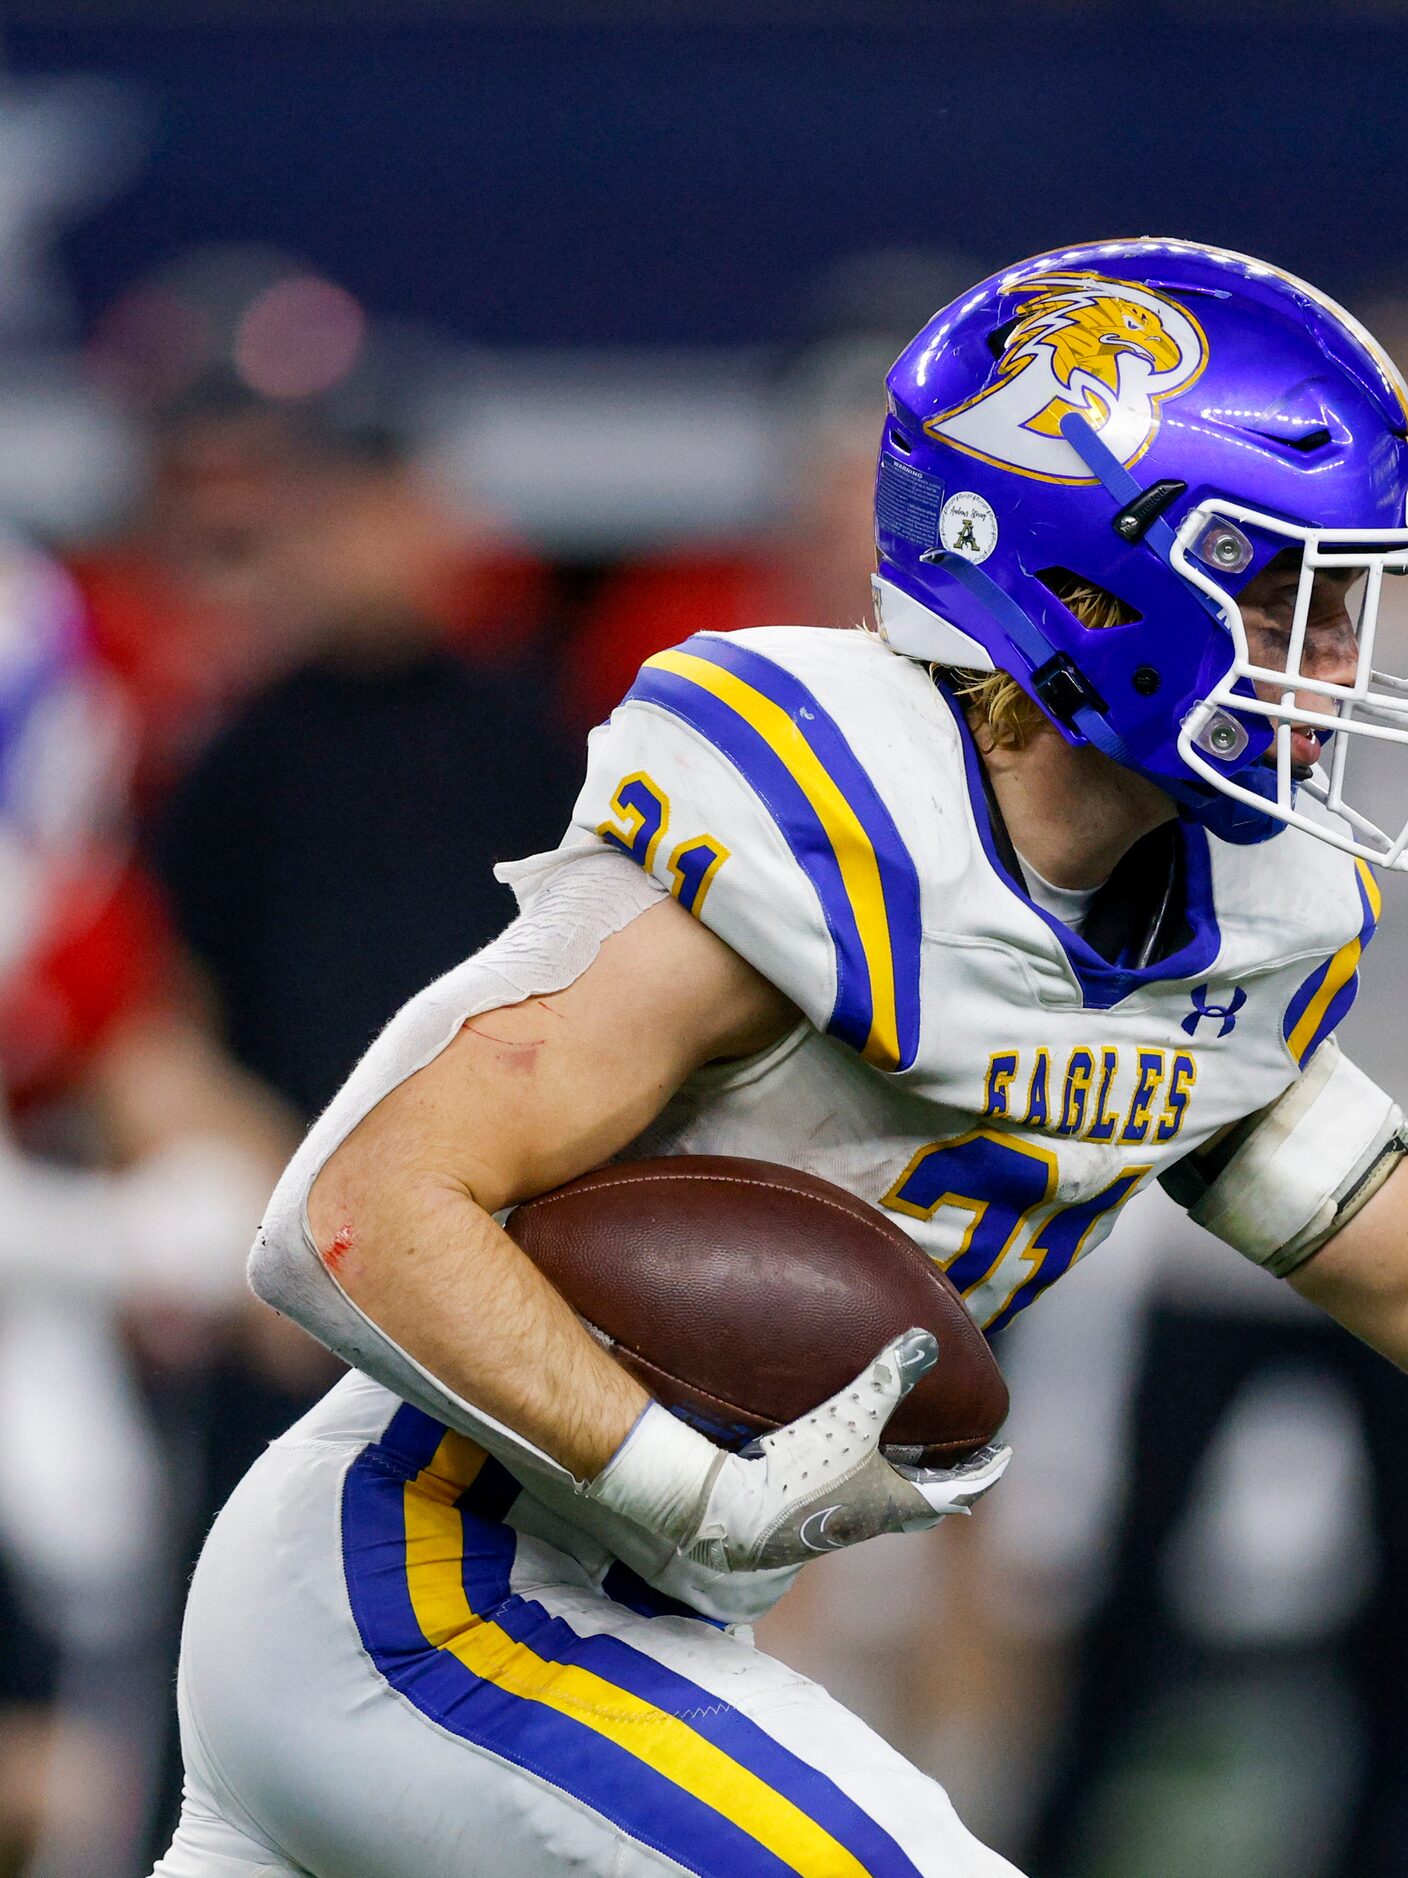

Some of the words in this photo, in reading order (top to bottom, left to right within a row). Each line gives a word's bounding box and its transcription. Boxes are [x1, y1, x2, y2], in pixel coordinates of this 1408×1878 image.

[893, 461, 923, 479] WARNING
[595, 770, 732, 923] 21
[981, 1045, 1198, 1147] EAGLES
[878, 1127, 1154, 1338] 21
